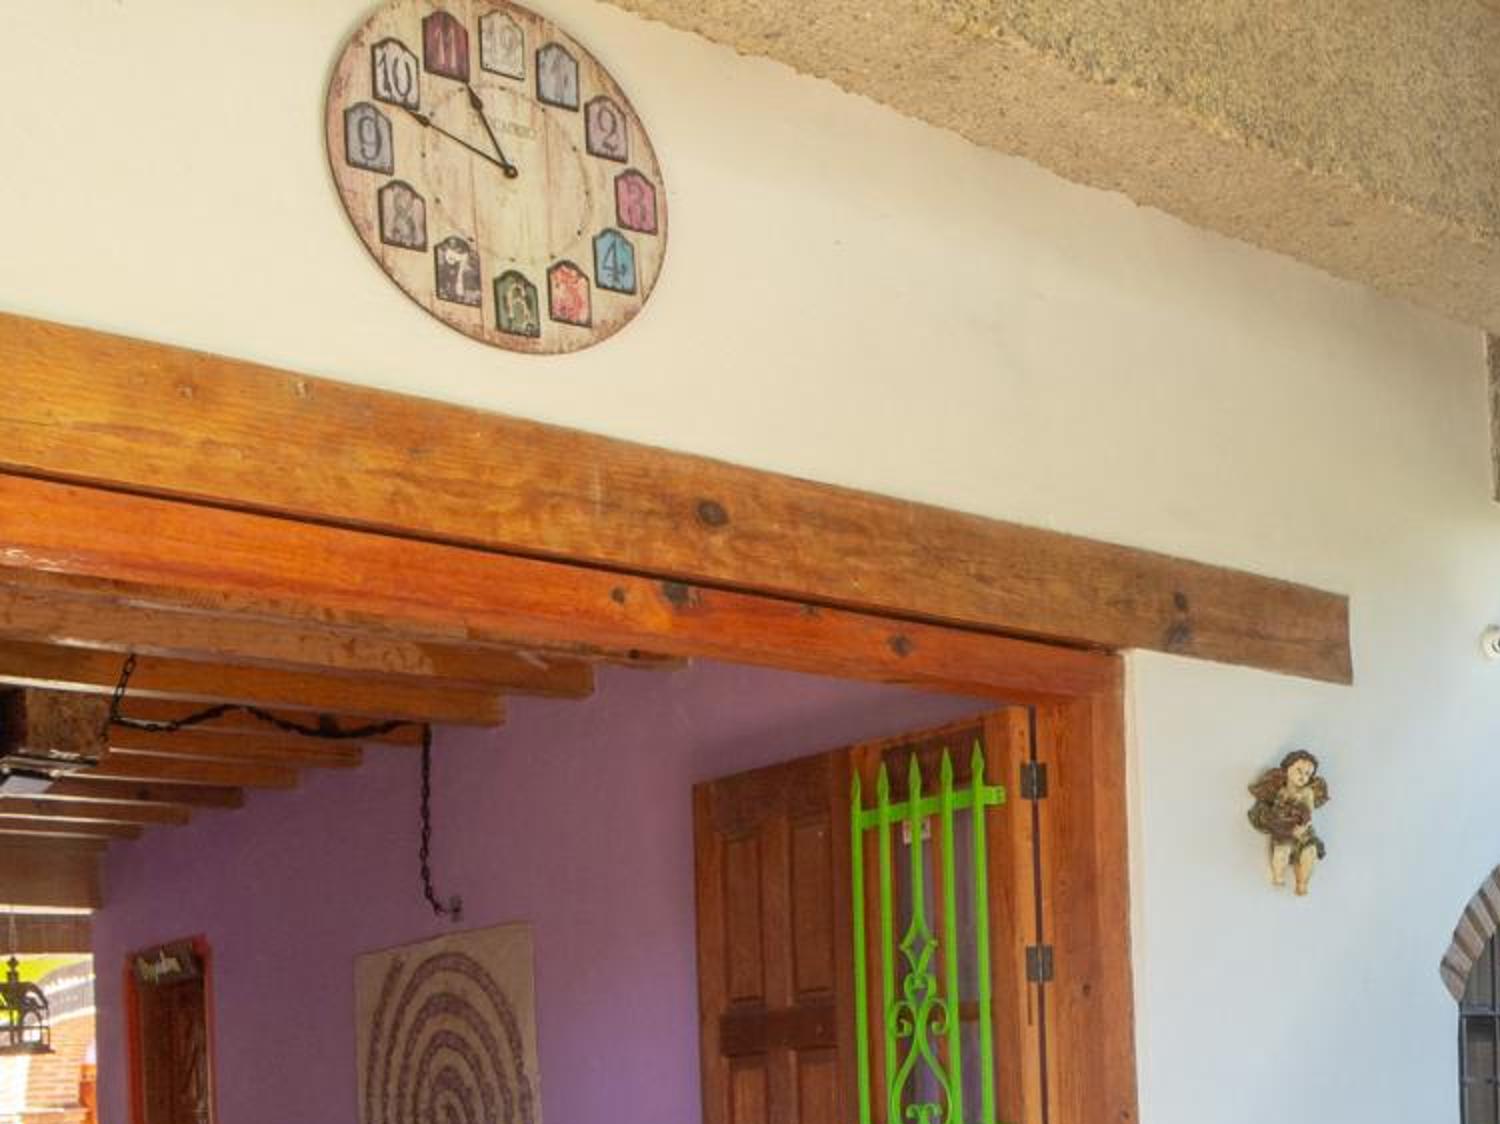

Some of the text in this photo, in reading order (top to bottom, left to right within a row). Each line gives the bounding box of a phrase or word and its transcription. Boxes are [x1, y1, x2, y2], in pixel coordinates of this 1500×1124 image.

[433, 26, 458, 70] 11
[377, 52, 413, 98] 10
[358, 115, 382, 161] 9
[597, 105, 622, 153] 2
[445, 246, 470, 296] 7
[602, 243, 627, 286] 4
